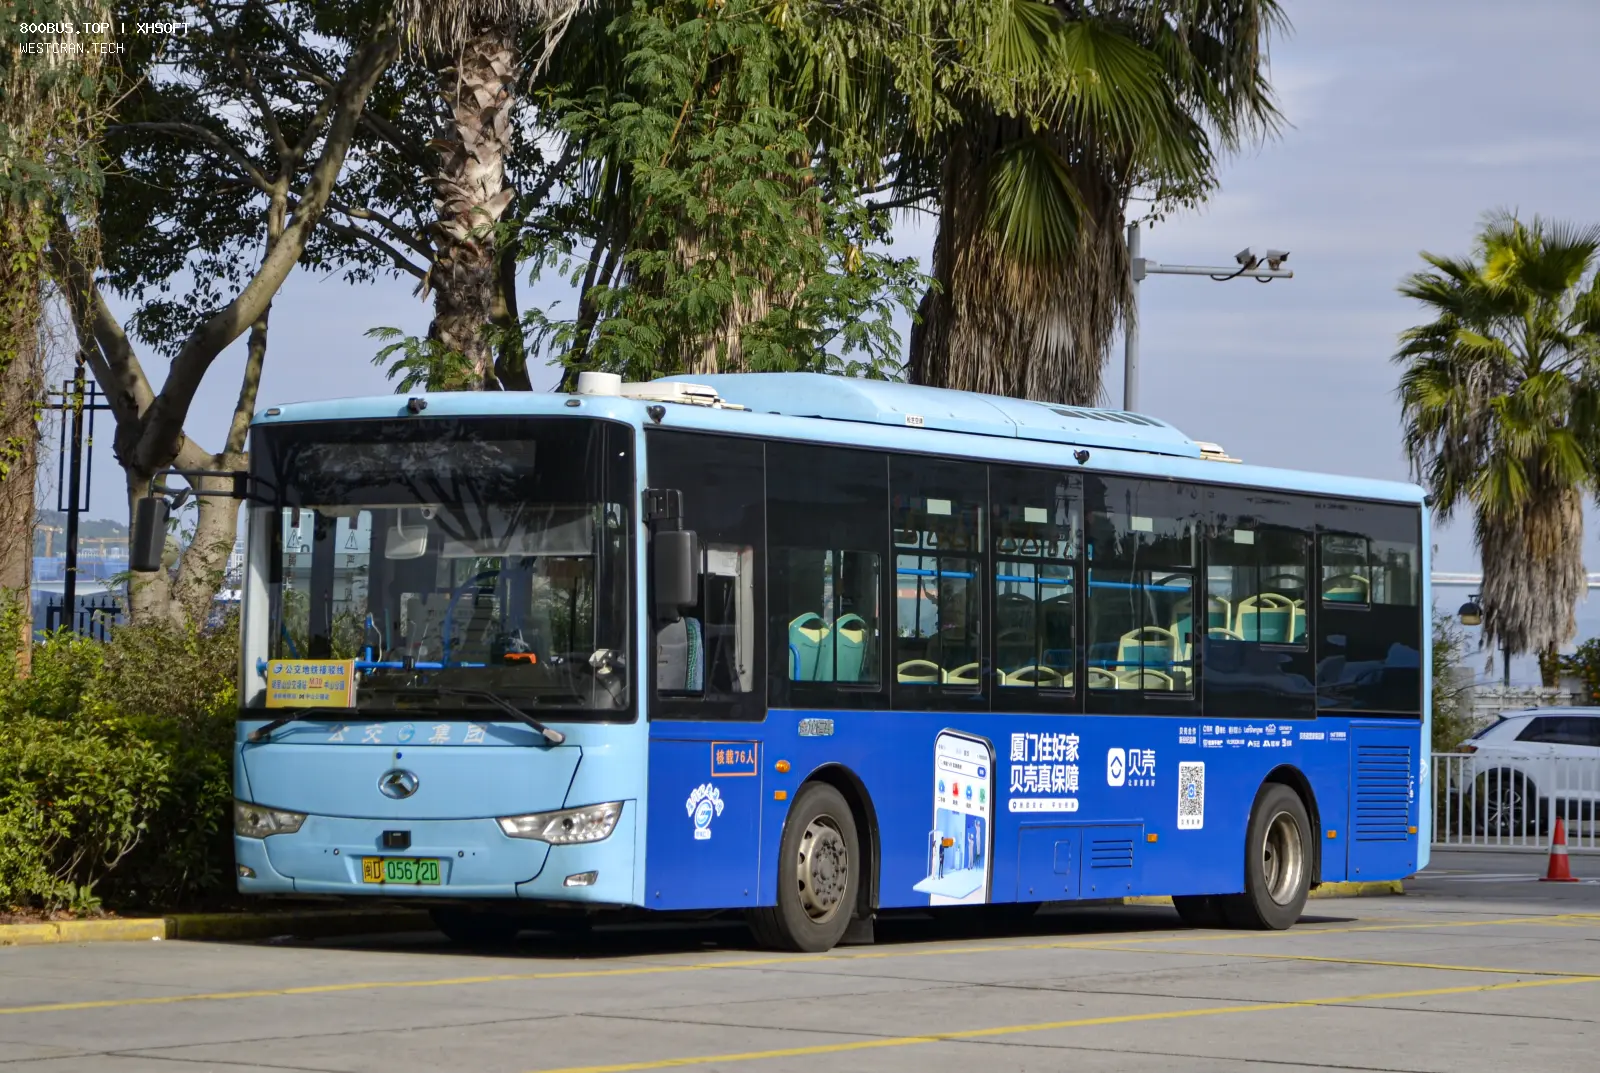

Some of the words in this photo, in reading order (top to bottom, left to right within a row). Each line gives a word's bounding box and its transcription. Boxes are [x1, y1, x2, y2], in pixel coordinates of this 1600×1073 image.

[715, 749, 755, 766] 核载76人
[1009, 732, 1080, 763] 厦门住好家
[1128, 748, 1156, 777] 贝壳
[1009, 764, 1080, 794] 贝壳真保障
